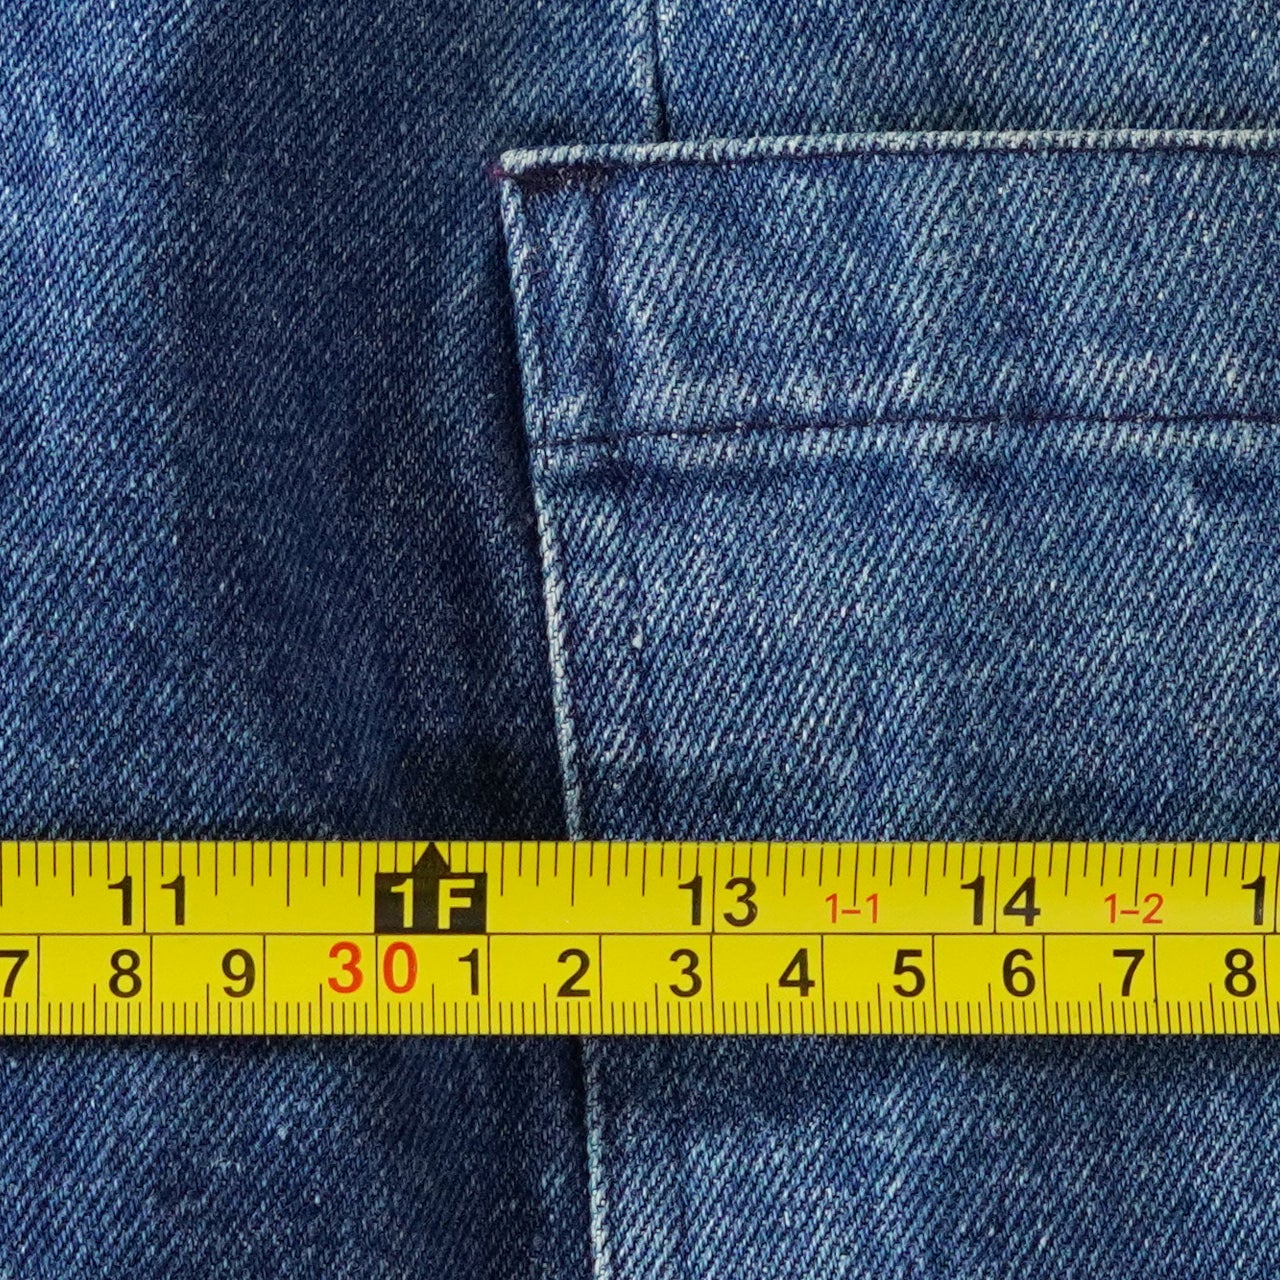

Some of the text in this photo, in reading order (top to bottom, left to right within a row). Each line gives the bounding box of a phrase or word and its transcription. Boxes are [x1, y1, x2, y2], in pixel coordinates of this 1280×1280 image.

[109, 877, 184, 926] 11
[390, 877, 475, 926] 1F
[679, 877, 758, 927] 13
[825, 893, 879, 924] 1-1
[961, 877, 1040, 926] 14
[1104, 893, 1163, 924] 1-2
[110, 950, 141, 998] 8
[223, 949, 254, 998] 9
[328, 941, 417, 995] 30
[459, 949, 479, 995] 1
[558, 949, 589, 997] 2
[671, 949, 702, 997] 3
[779, 949, 814, 996] 4
[895, 950, 925, 997] 5
[1003, 949, 1035, 997] 6
[1114, 950, 1144, 996] 7
[1225, 949, 1256, 997] 8
